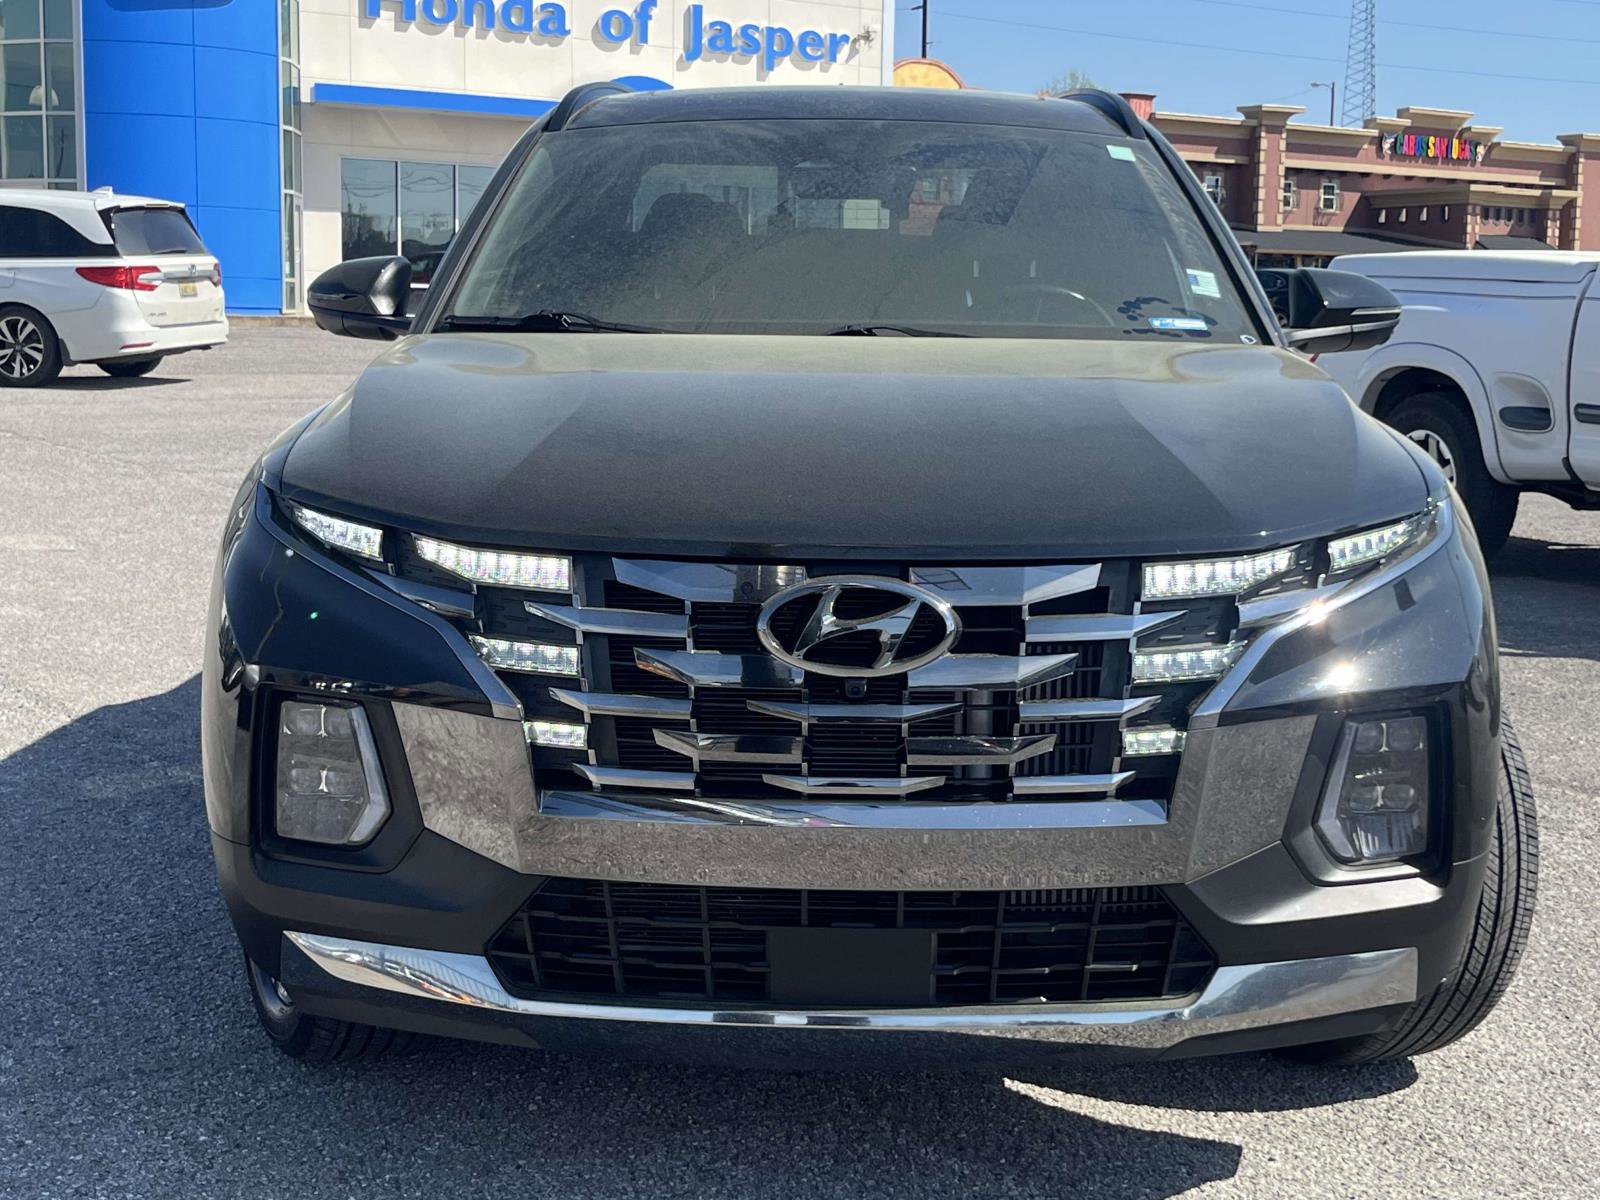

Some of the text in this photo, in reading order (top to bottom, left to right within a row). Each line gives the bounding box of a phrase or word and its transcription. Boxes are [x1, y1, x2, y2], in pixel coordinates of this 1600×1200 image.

[599, 0, 657, 44] of
[683, 4, 850, 71] Jasper
[1428, 135, 1448, 158] SAN
